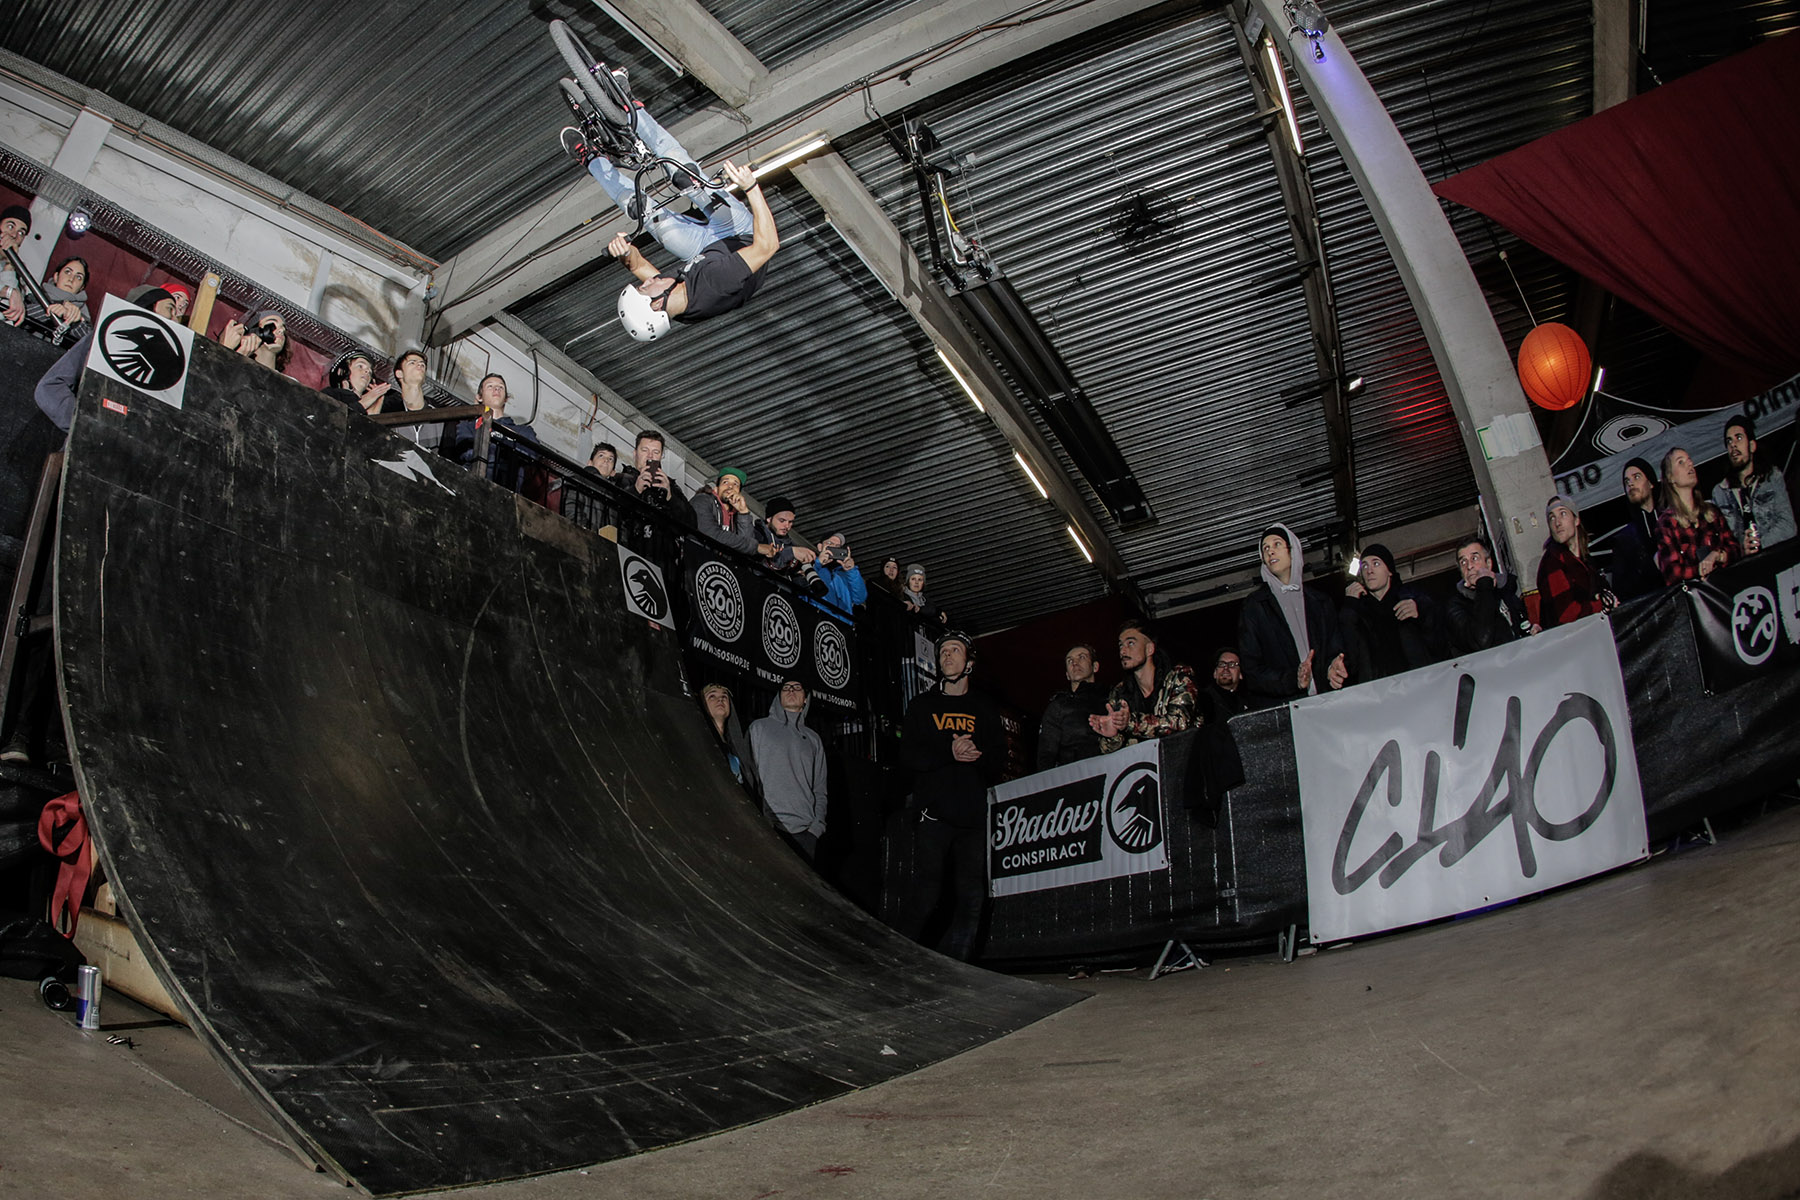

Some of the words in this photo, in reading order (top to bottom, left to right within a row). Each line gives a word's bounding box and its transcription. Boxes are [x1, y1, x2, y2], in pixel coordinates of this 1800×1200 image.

[1743, 380, 1800, 420] prim
[706, 587, 735, 619] 360
[768, 618, 793, 646] 360
[821, 642, 841, 669] 360
[931, 712, 977, 733] VANS
[991, 798, 1100, 851] Shadow
[1001, 840, 1088, 870] CONSPIRACY
